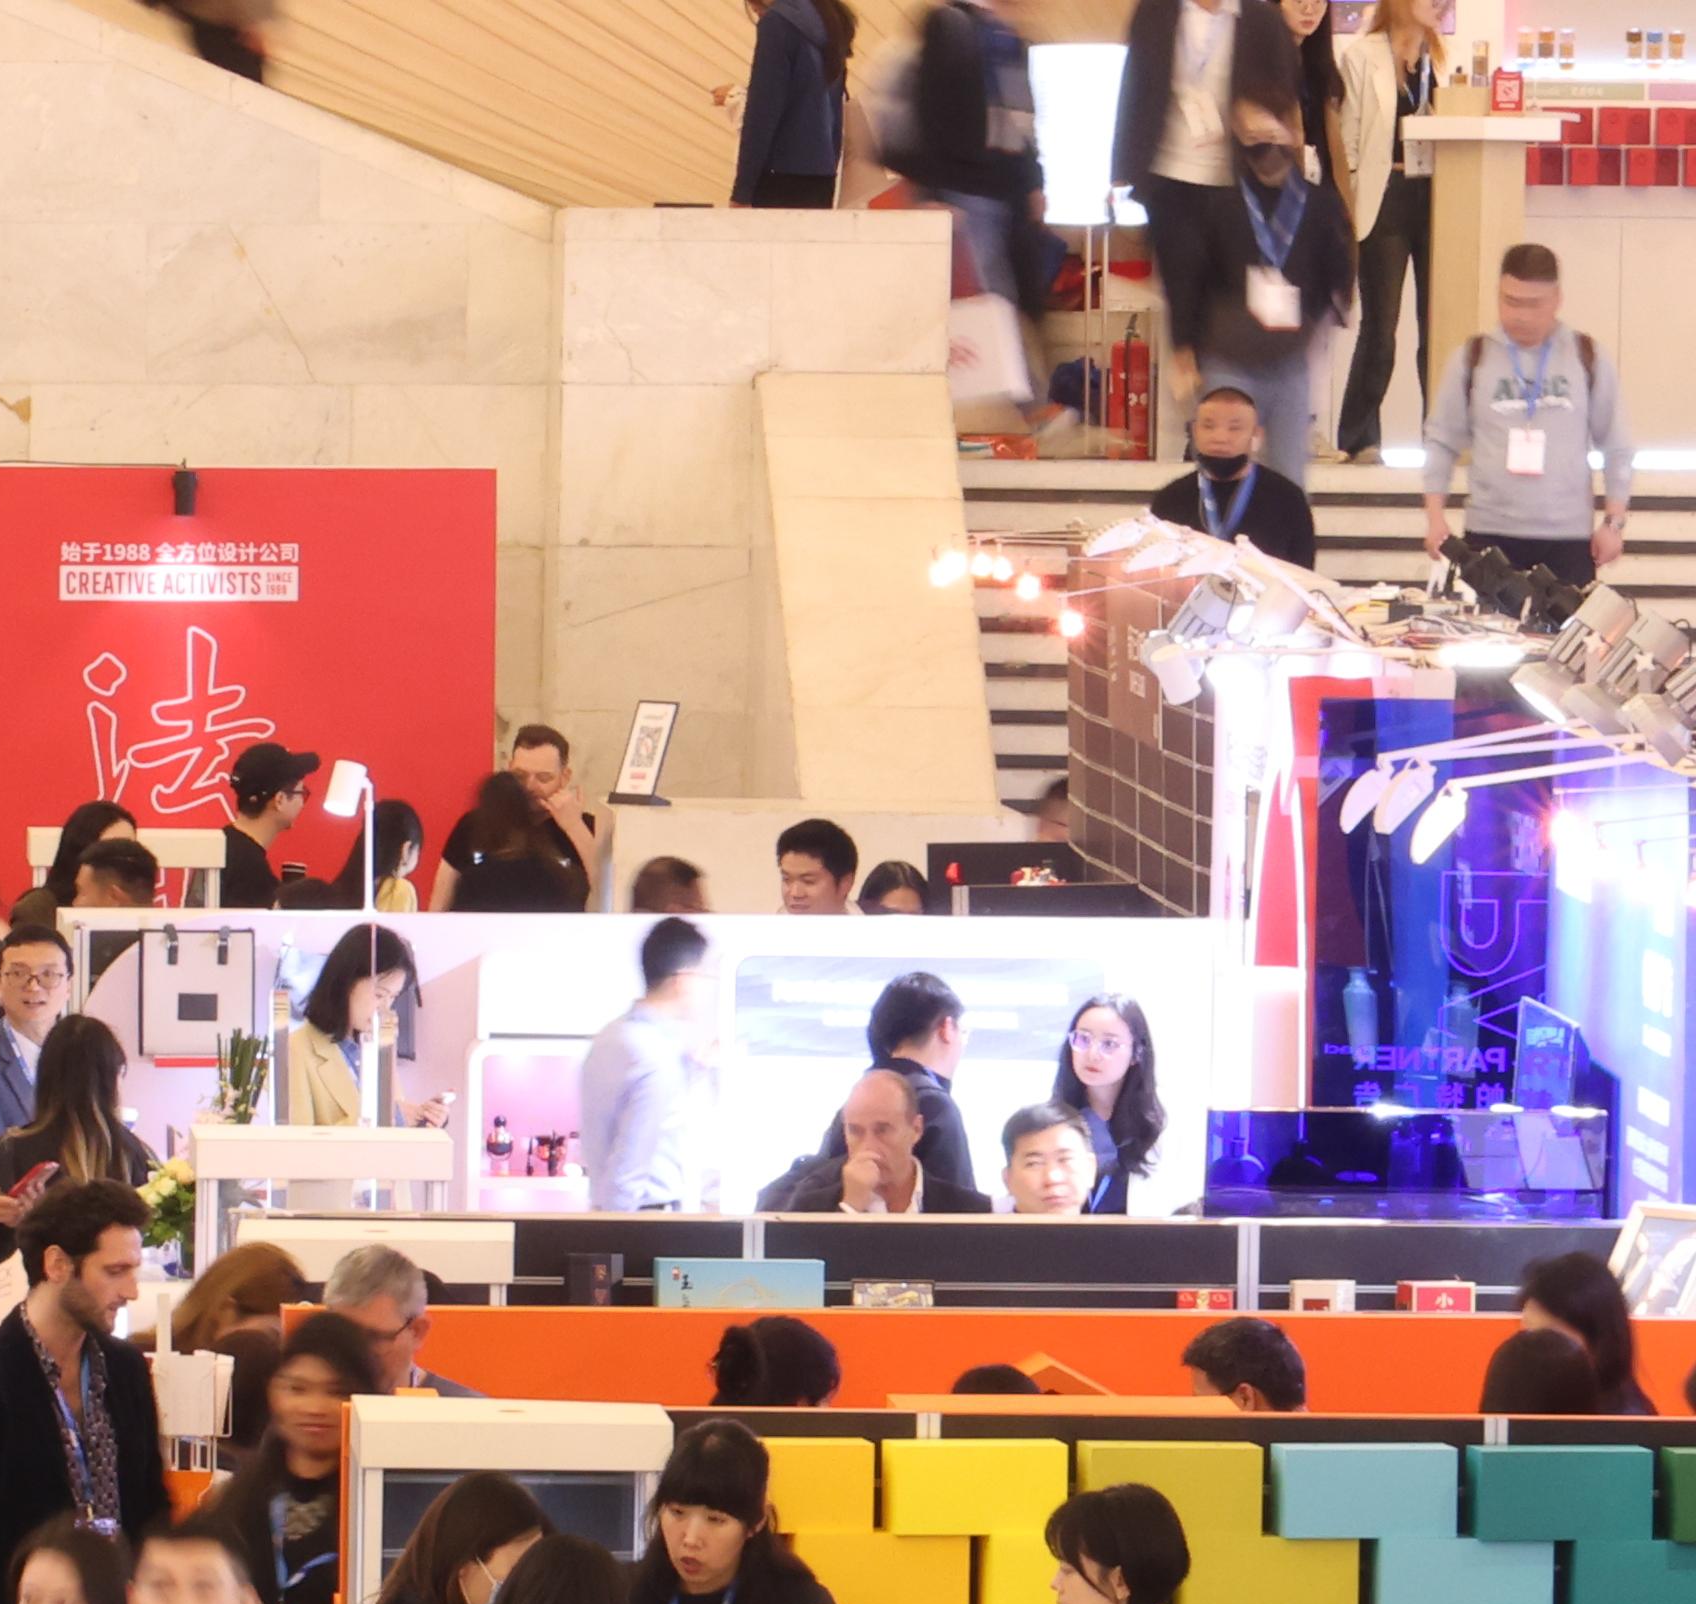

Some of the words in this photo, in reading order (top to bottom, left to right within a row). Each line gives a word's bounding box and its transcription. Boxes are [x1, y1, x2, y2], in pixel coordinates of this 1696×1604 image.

[61, 542, 151, 563] 始于1988
[155, 542, 299, 563] 全方位设计公司
[66, 572, 156, 595] CREATIVE
[162, 572, 262, 595] ACTIVISTS
